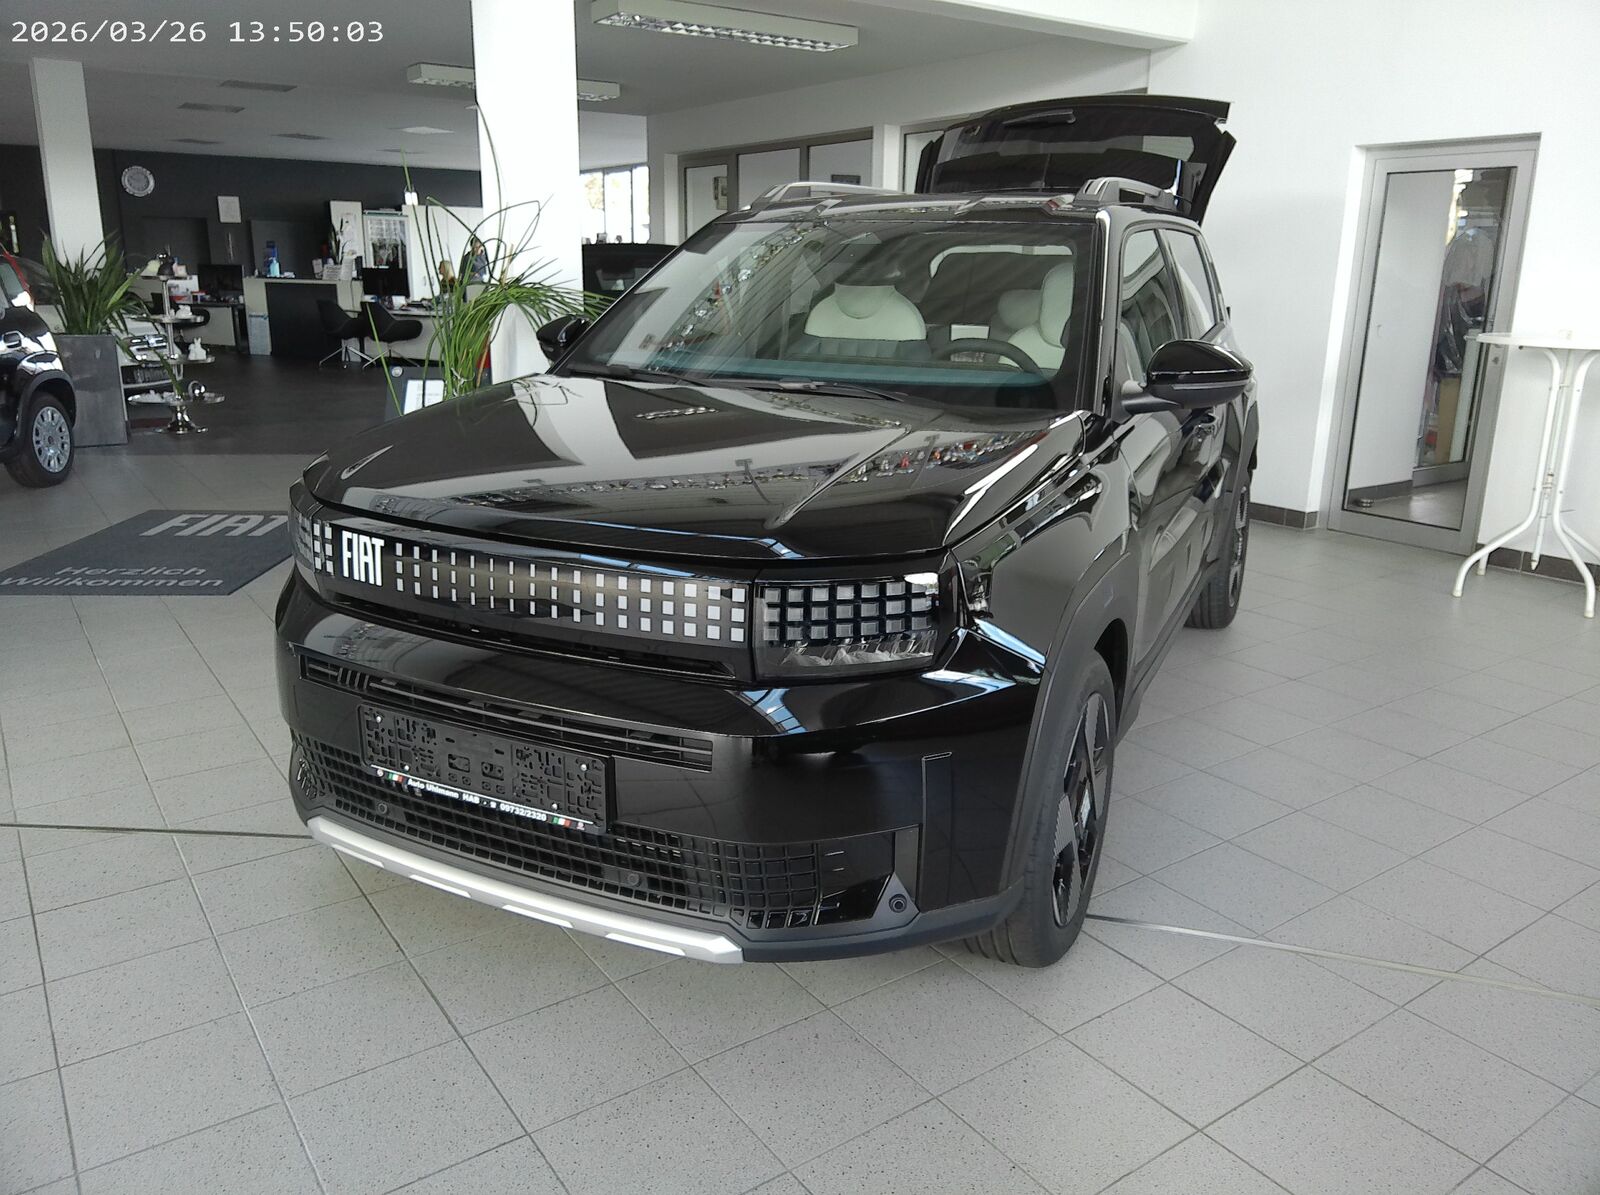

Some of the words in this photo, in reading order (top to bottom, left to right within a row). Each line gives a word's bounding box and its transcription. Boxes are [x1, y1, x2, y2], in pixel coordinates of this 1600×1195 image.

[139, 514, 289, 537] FIAT
[342, 530, 385, 586] FIAT
[55, 566, 207, 576] Herzlich
[0, 577, 224, 587] Willkommen
[407, 778, 425, 790] Auto
